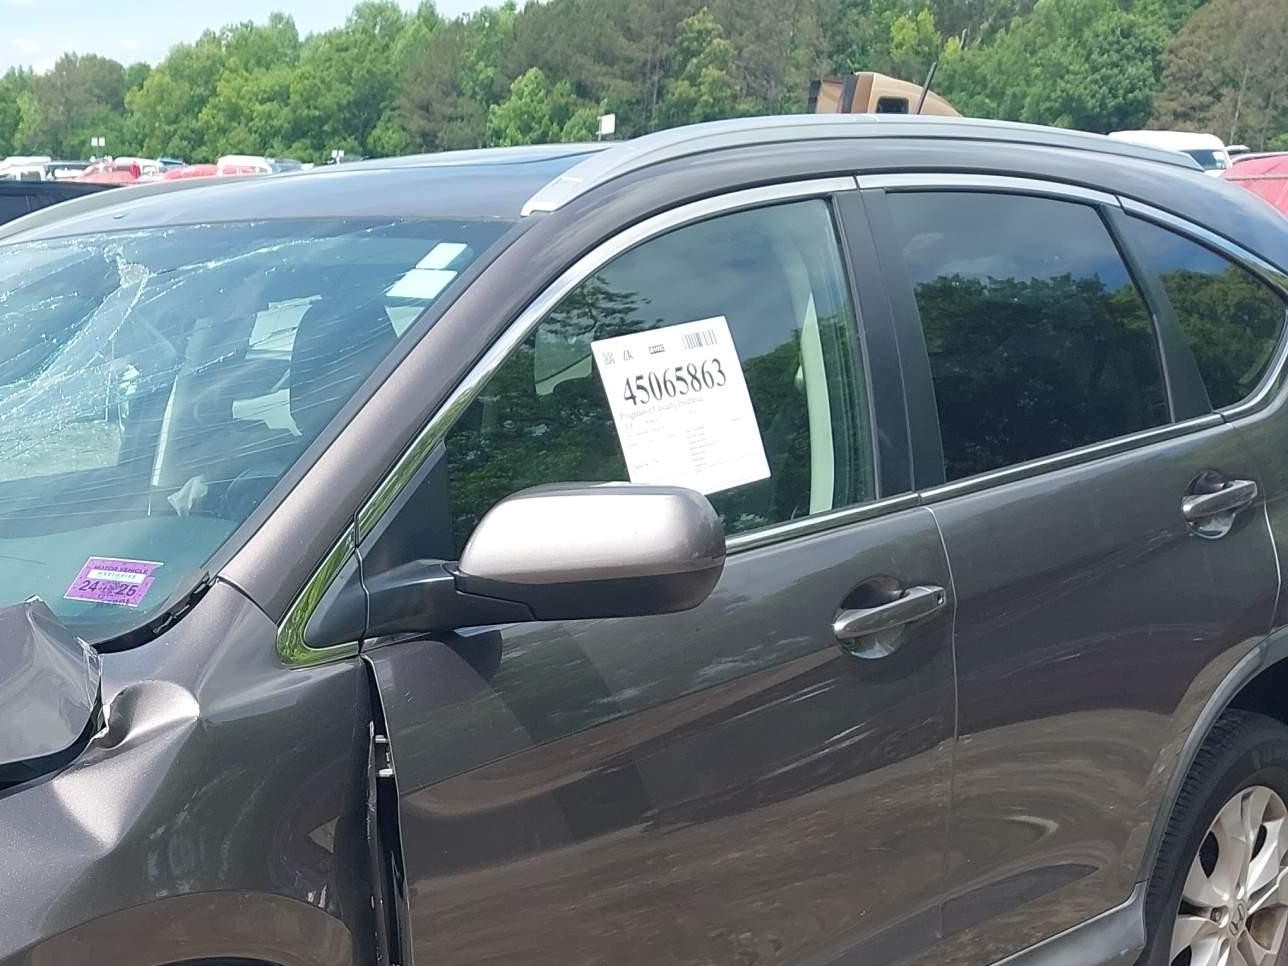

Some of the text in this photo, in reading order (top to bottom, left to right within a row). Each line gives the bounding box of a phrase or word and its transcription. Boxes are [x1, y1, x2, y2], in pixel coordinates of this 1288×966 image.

[623, 358, 727, 406] 45065863
[79, 579, 98, 592] 24
[115, 583, 139, 596] 25
